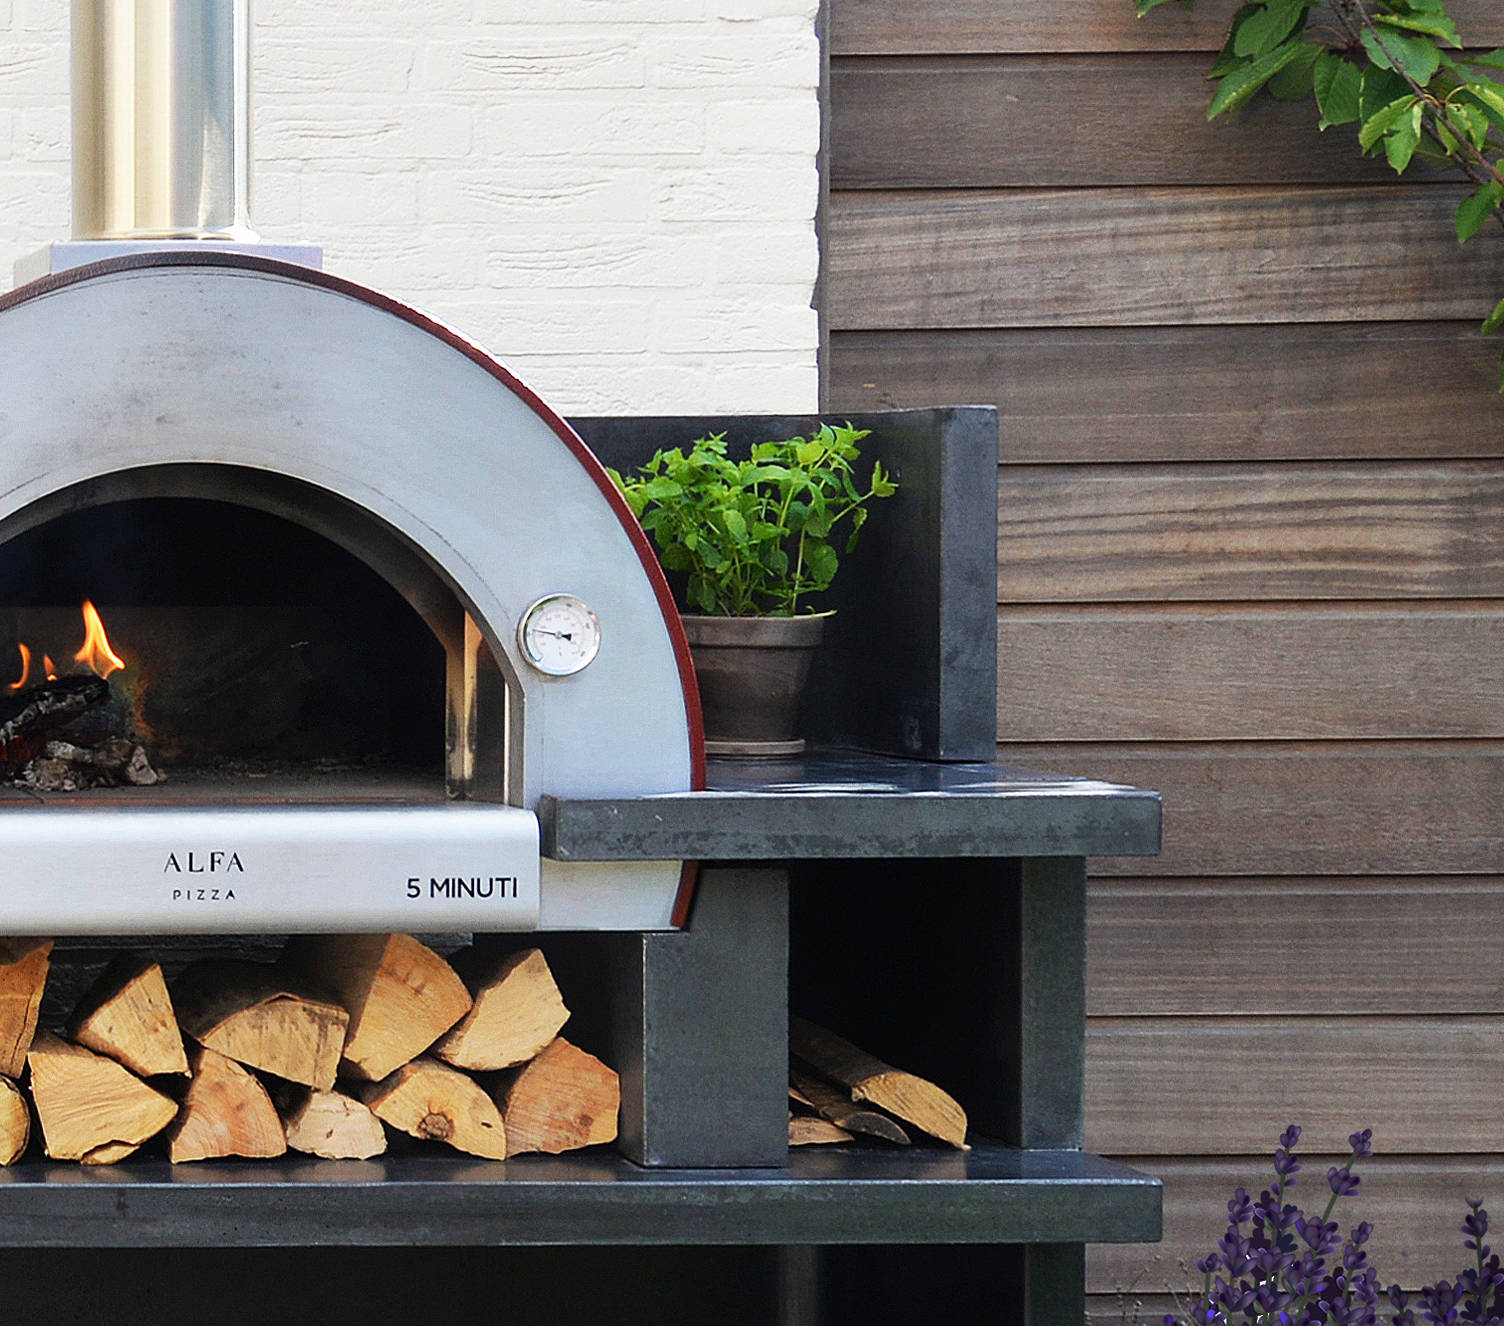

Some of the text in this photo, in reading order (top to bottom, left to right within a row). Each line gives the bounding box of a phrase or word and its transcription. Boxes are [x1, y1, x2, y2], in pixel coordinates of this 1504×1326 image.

[163, 851, 244, 873] ALFA
[172, 889, 236, 901] PIZZA
[406, 877, 517, 898] 5 MINUTI
